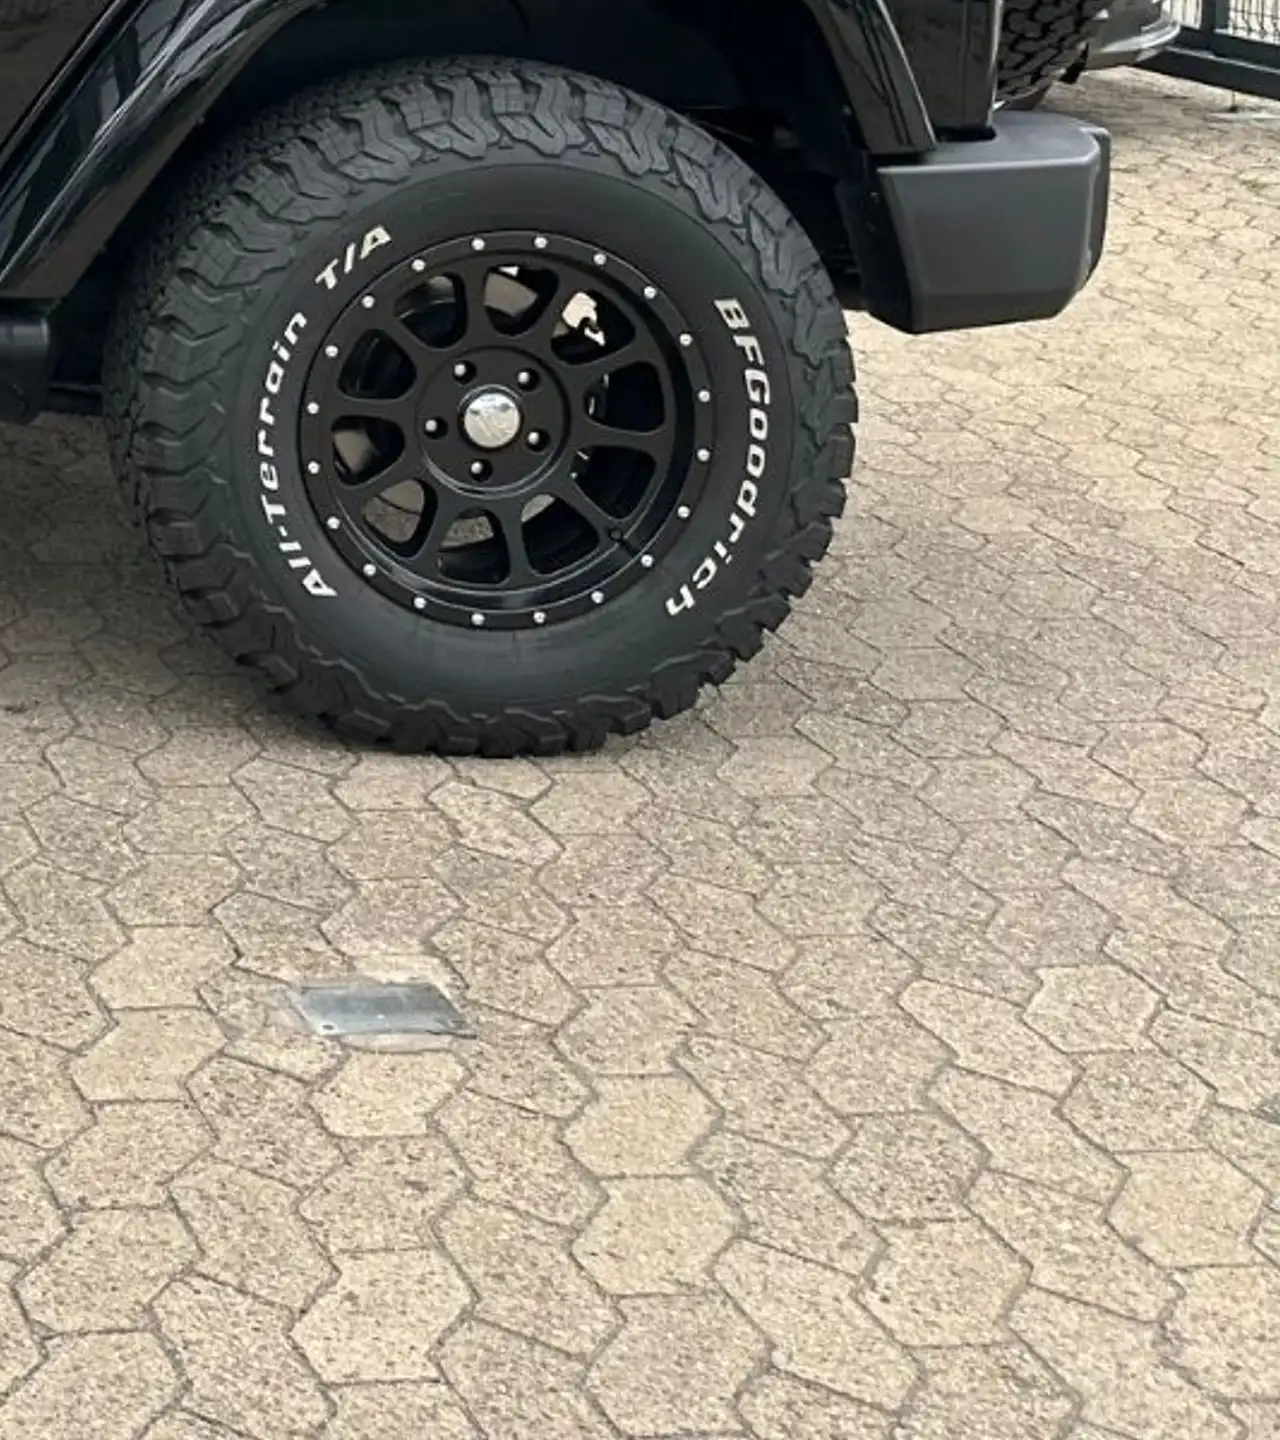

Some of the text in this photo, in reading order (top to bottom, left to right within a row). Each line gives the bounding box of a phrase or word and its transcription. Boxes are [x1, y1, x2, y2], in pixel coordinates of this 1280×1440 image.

[257, 225, 392, 597] All-Terrain T/A
[665, 298, 771, 616] BFGoodrich
